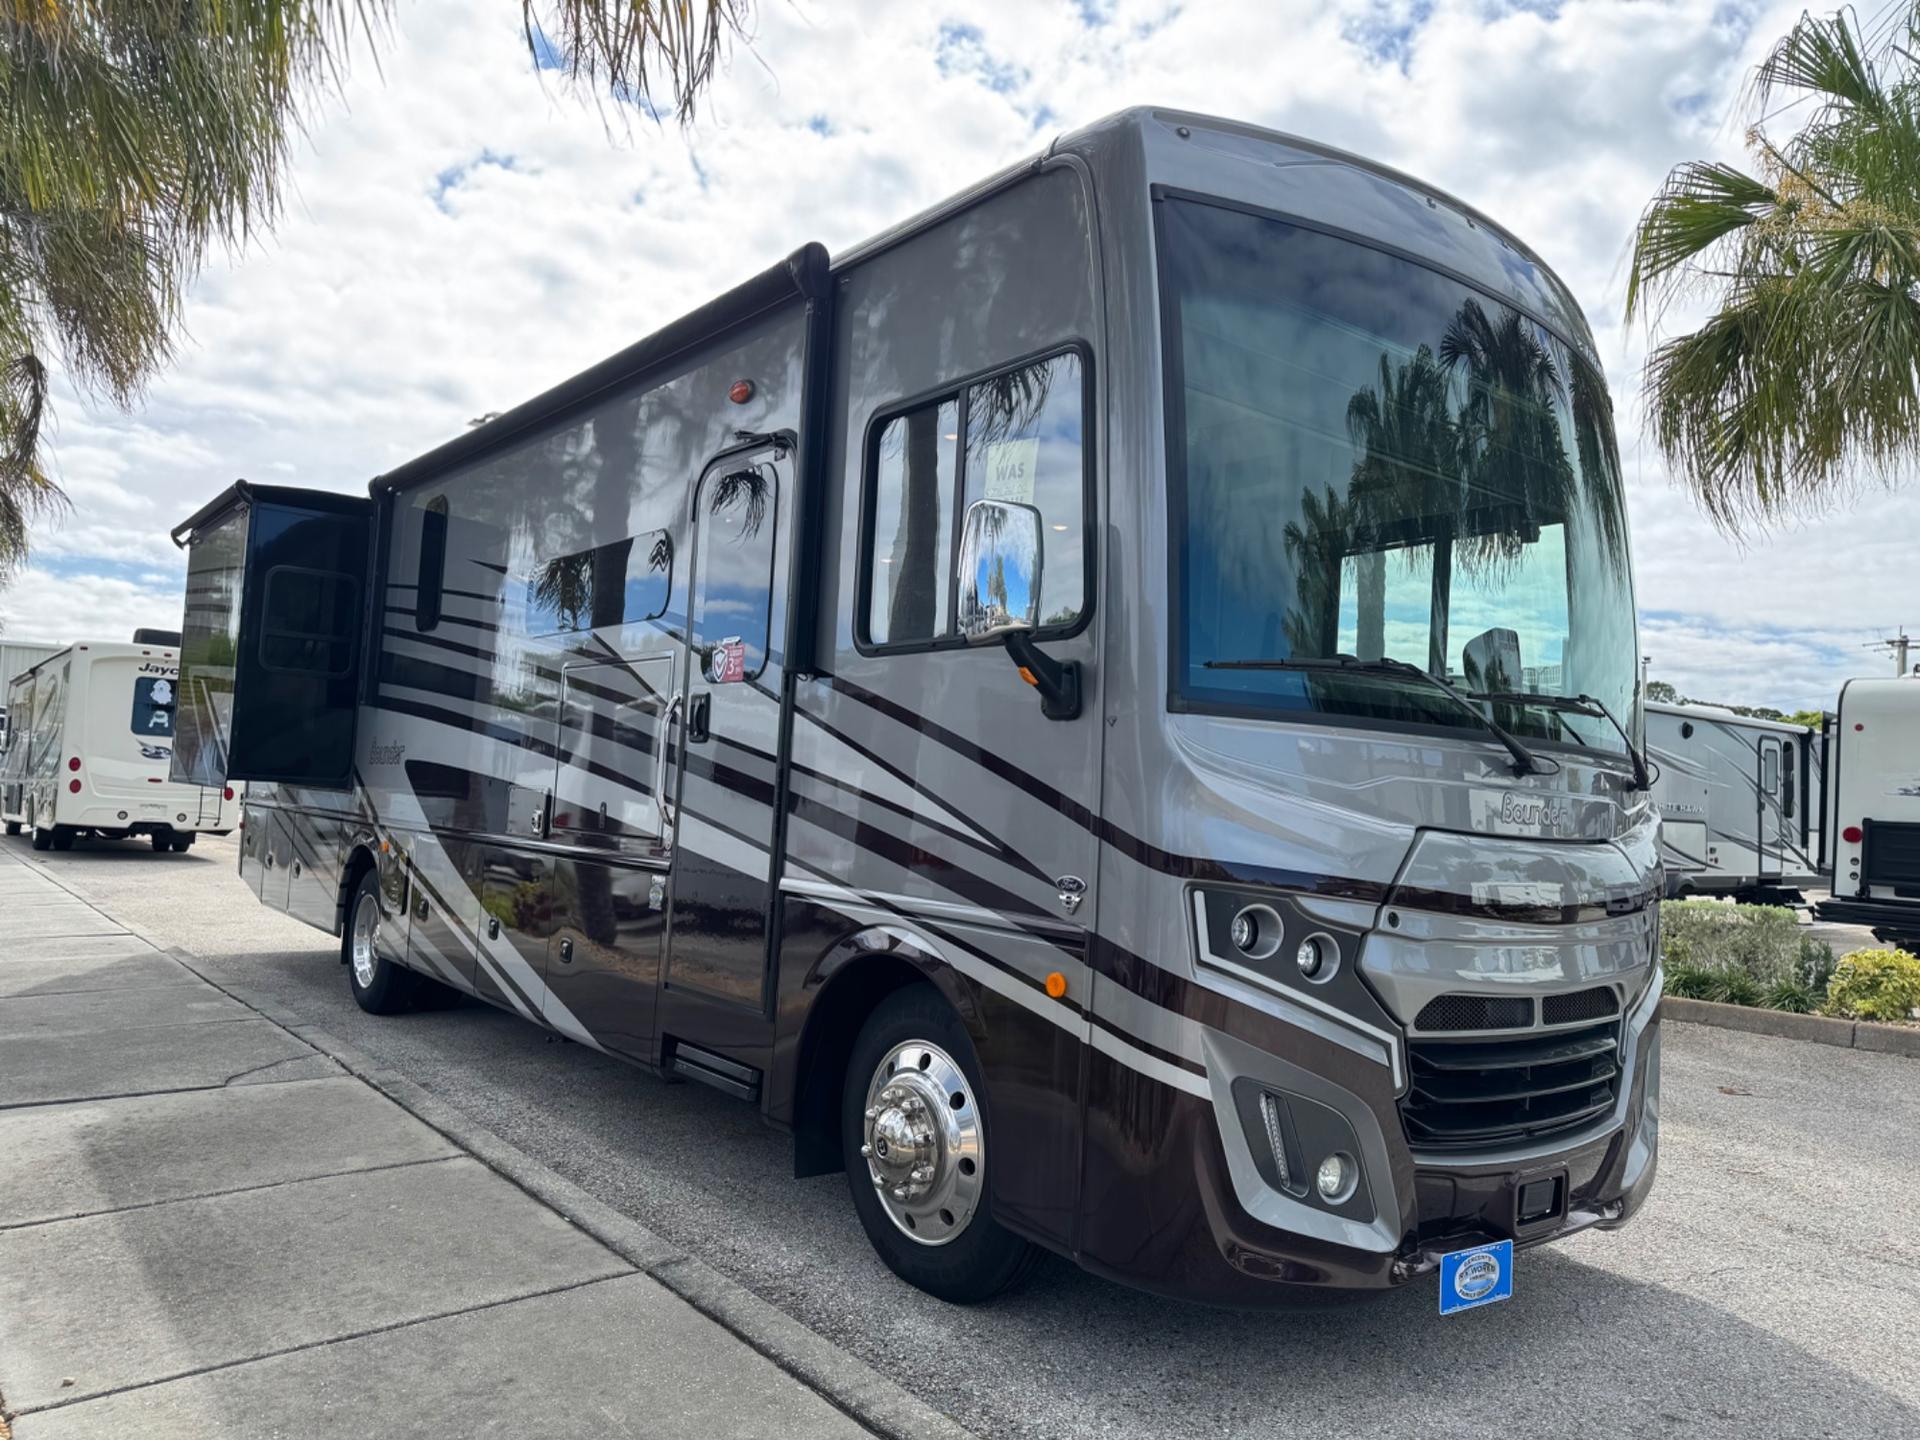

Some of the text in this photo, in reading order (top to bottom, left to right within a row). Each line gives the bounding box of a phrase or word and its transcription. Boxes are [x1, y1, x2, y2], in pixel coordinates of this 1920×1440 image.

[995, 462, 1026, 482] WAS
[727, 658, 735, 675] 3
[1501, 791, 1568, 827] Bounder
